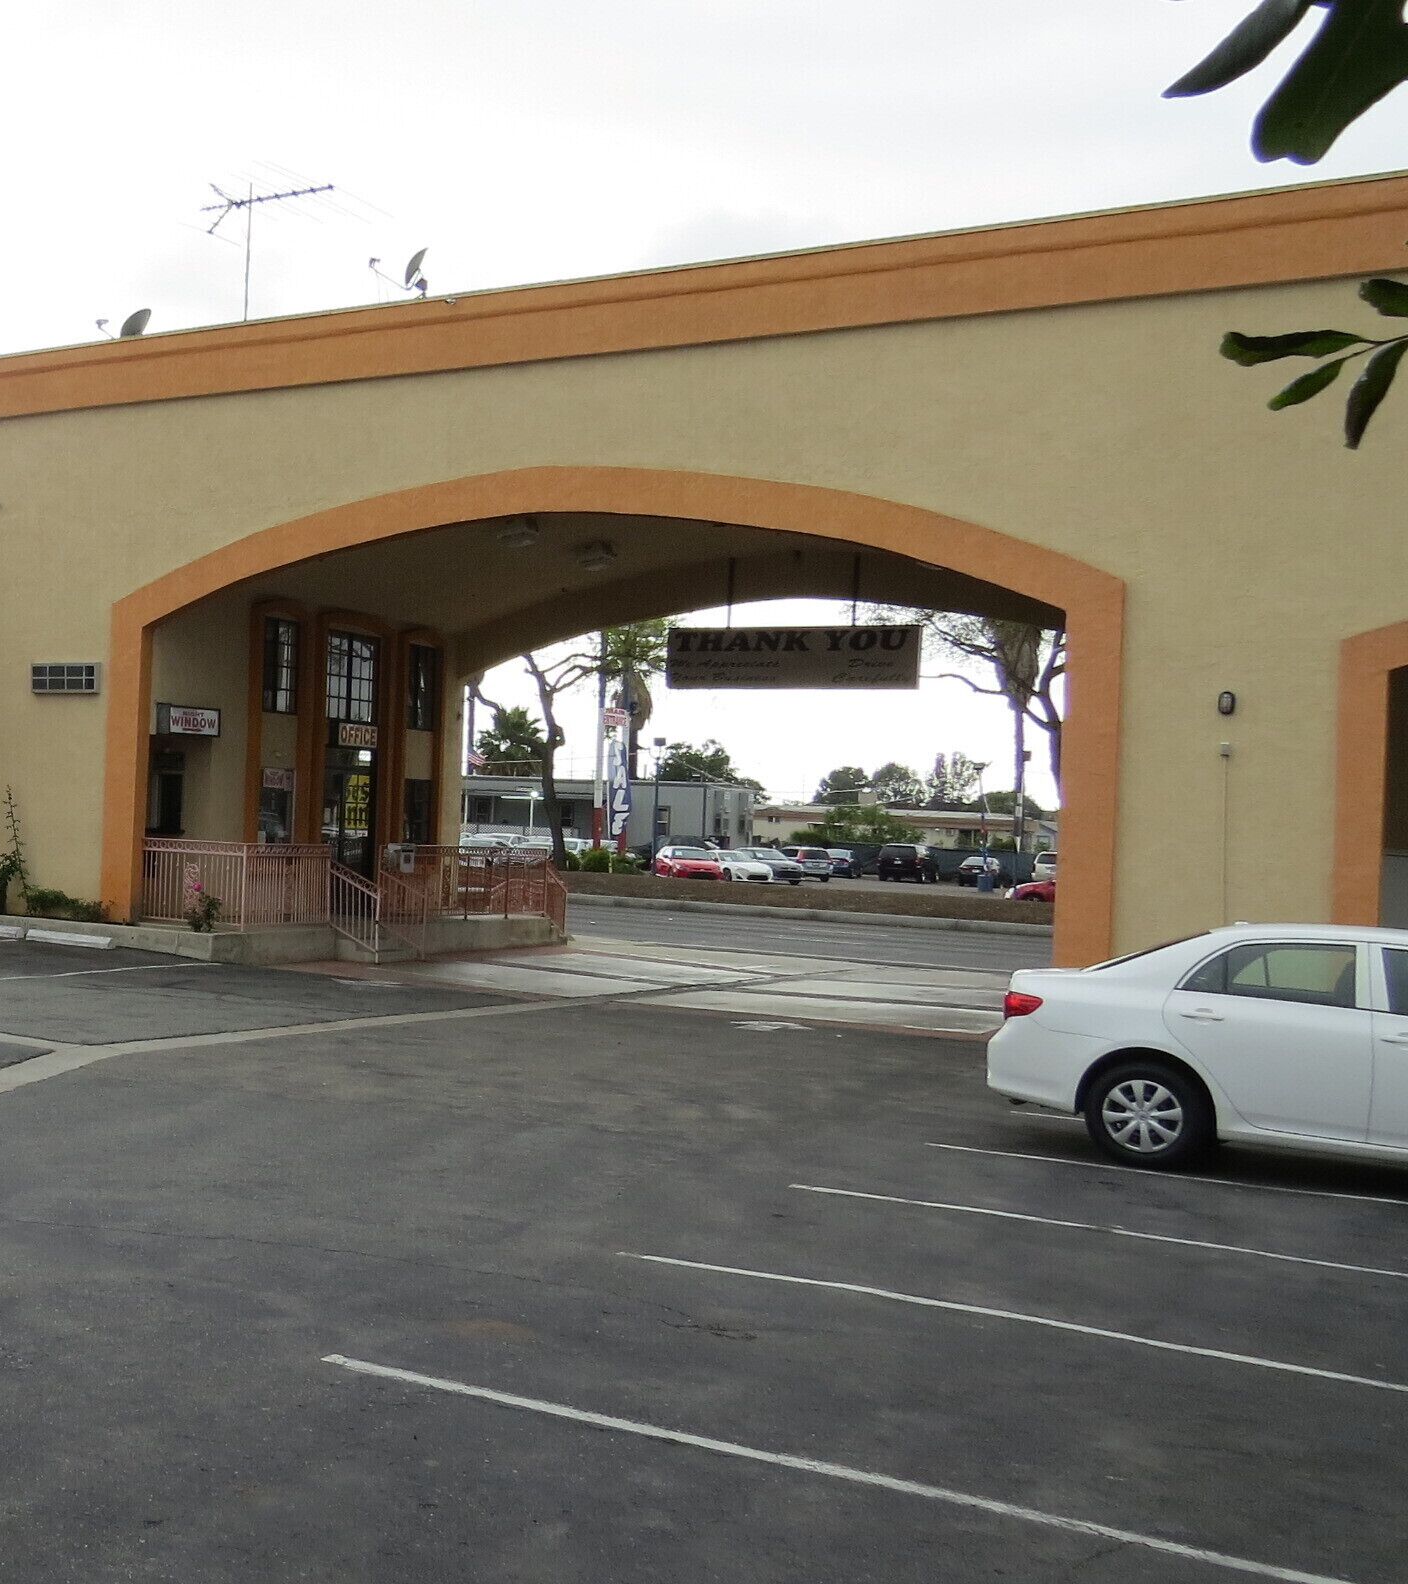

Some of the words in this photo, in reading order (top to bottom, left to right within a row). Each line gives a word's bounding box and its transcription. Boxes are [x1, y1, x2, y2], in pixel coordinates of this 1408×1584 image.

[673, 630, 810, 651] THANK
[824, 629, 909, 651] YOU
[697, 659, 780, 670] Appreciate
[848, 658, 894, 668] Drive
[182, 710, 205, 718] NIGHT
[170, 715, 217, 729] WINDOW
[340, 725, 377, 746] OFFICE
[611, 740, 630, 836] SALE
